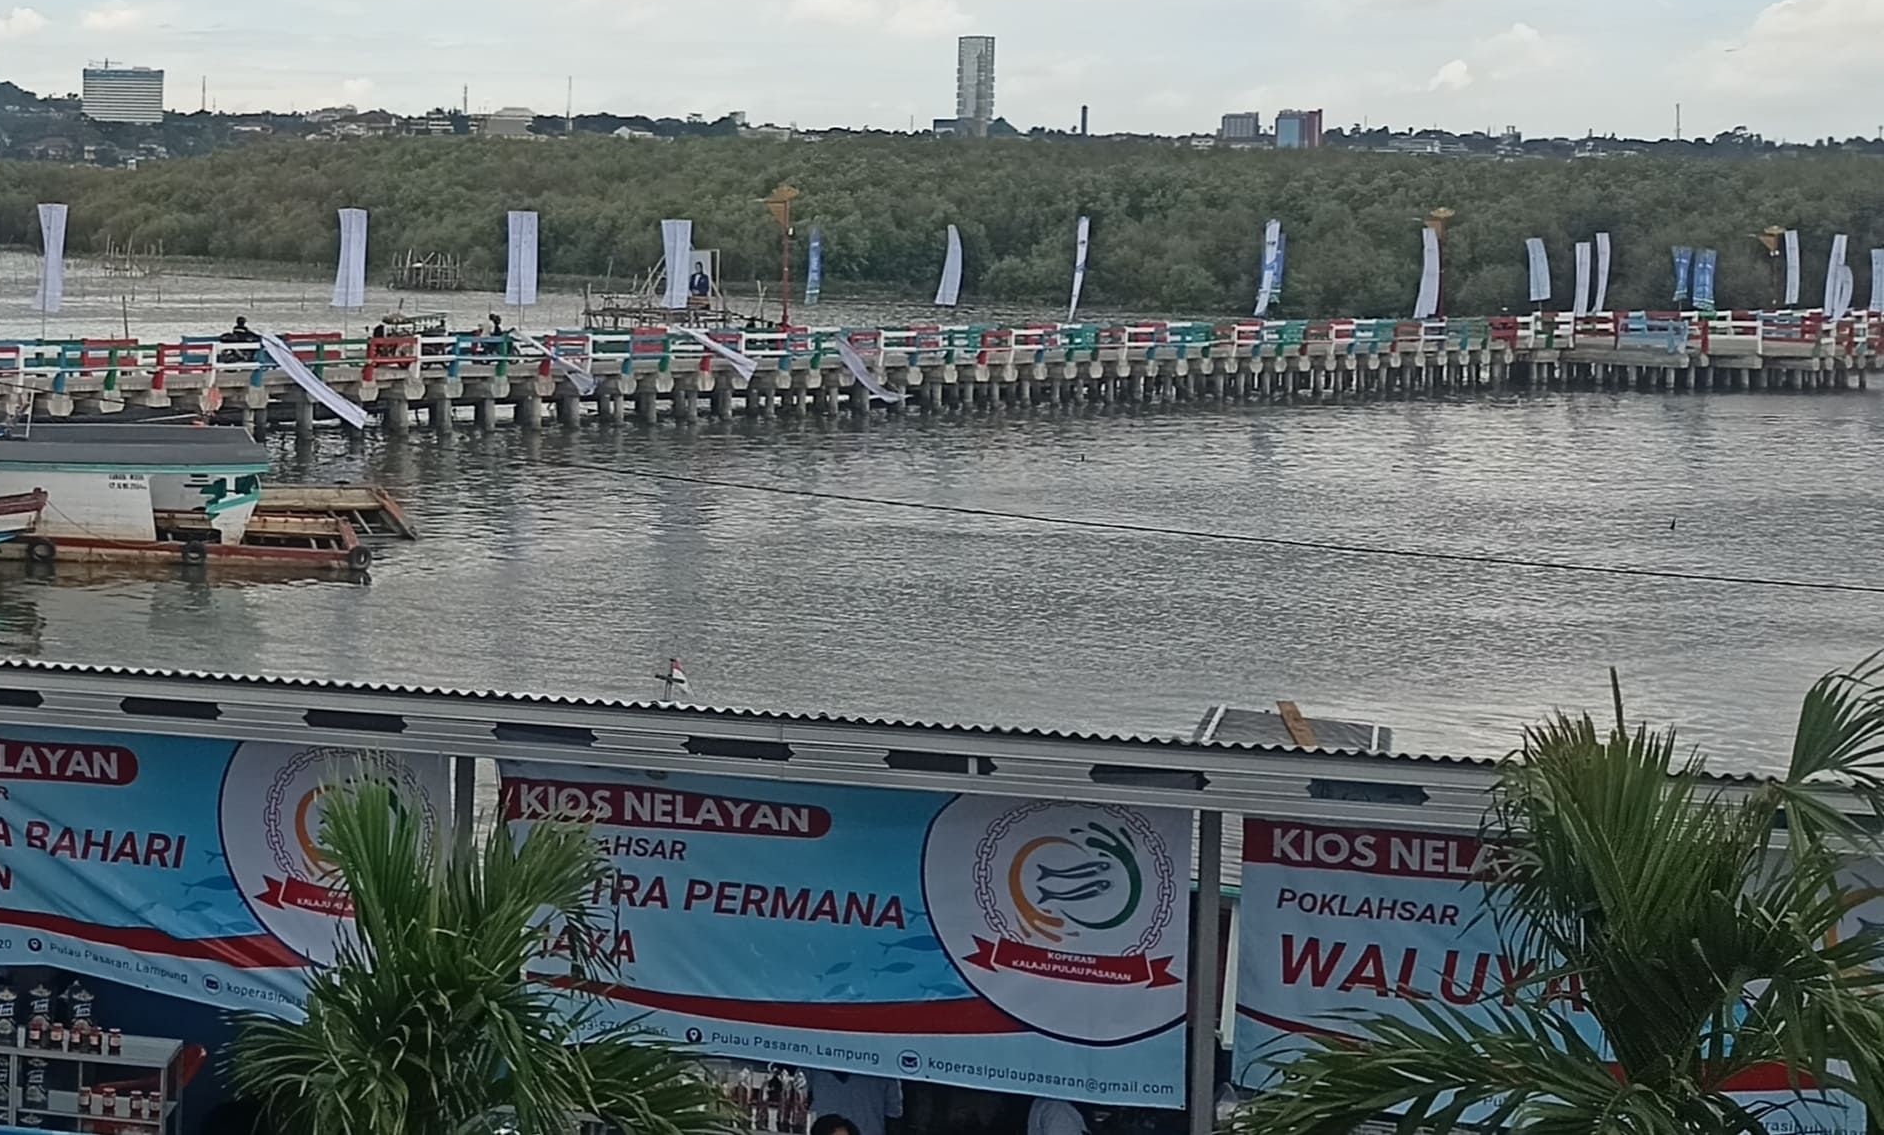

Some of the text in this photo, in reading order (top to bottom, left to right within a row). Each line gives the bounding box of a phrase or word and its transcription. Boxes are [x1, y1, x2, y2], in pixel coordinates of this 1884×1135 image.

[519, 784, 811, 834] KIOS NELAYAN
[25, 820, 187, 869] BAHARI
[1271, 827, 1503, 876] KIOS NELA
[683, 878, 907, 930] PERMANA
[1276, 887, 1460, 926] POKLAHSAR
[1012, 959, 1132, 982] KALAJU PULAU PASARAN
[1047, 951, 1096, 964] KOPERASI
[711, 1031, 749, 1048] Pulau
[753, 1035, 814, 1055] Pasaran,
[817, 1044, 880, 1065] Lampung
